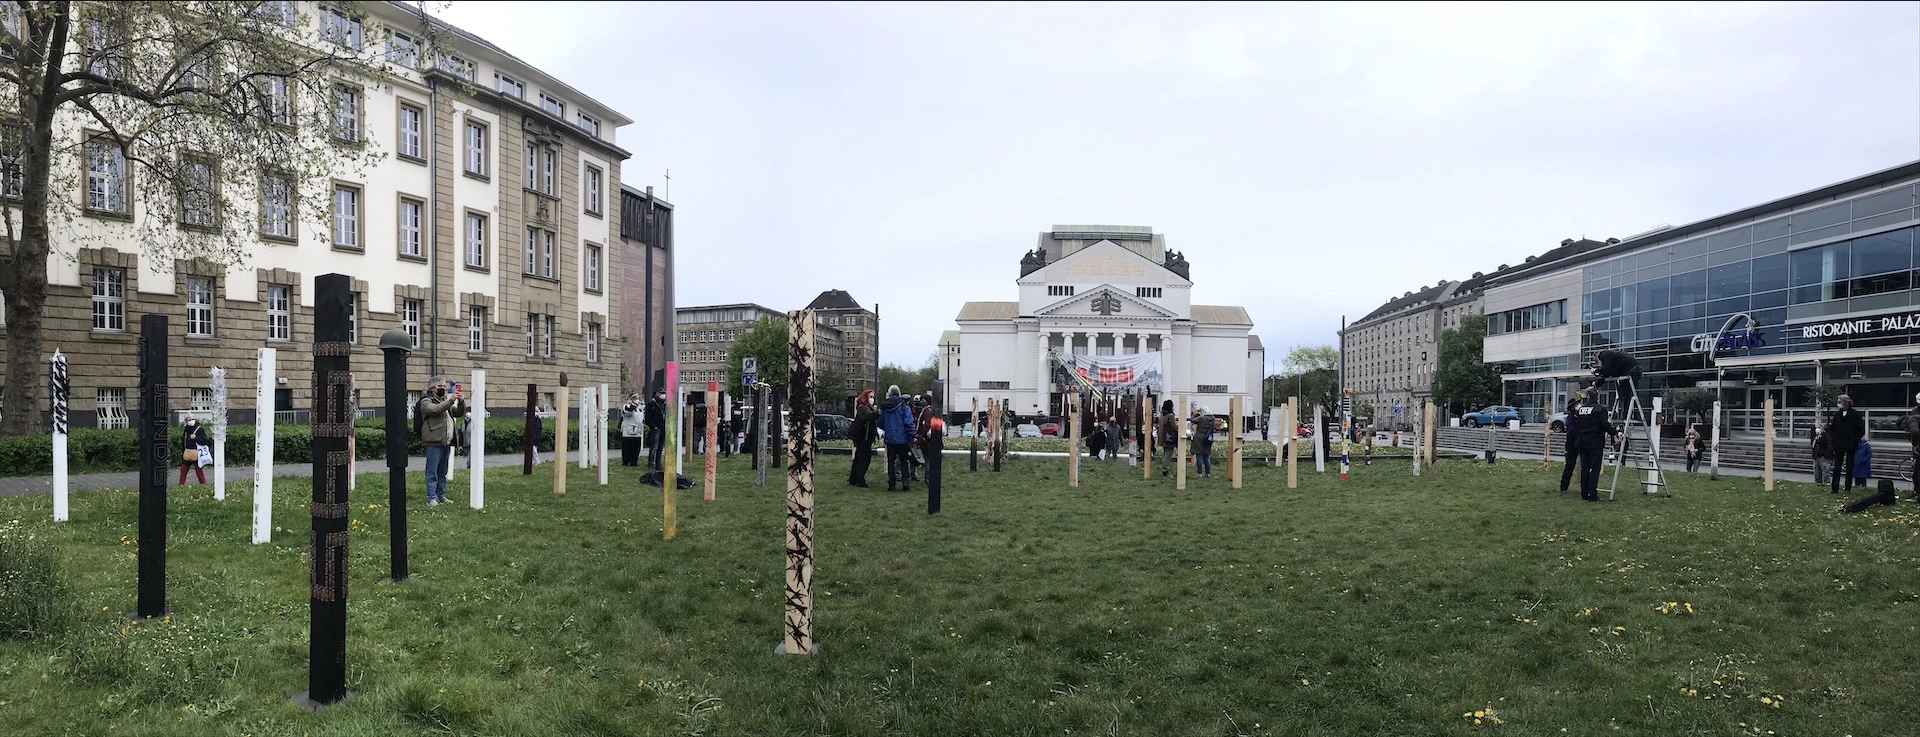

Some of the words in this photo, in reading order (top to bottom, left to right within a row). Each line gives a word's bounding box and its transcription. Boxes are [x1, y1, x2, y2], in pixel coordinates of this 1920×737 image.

[1803, 320, 1872, 339] RISTORANTE
[1099, 365, 1135, 383] Mai
[1579, 406, 1594, 416] CREW
